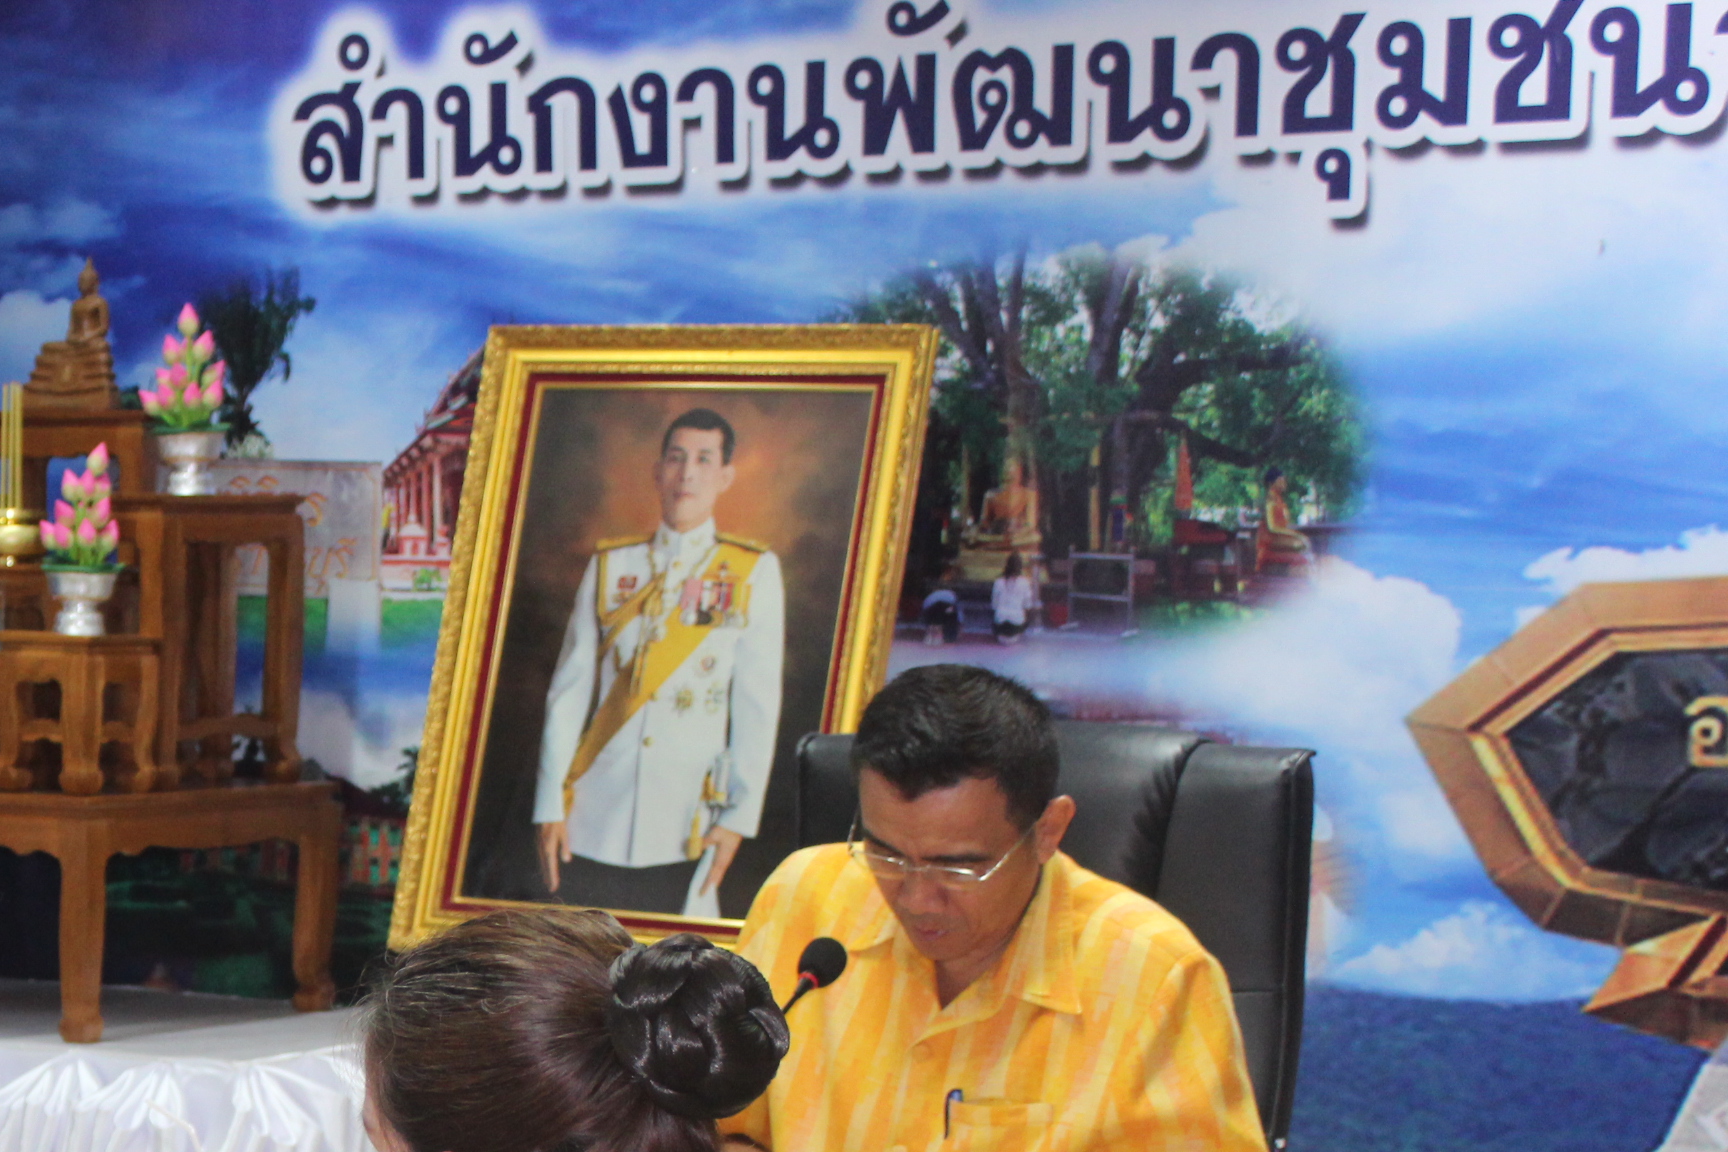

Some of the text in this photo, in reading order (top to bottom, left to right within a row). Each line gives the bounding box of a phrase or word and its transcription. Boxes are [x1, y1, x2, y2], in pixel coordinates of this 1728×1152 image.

[292, 0, 1728, 202] สำนักงานพัฒนาชุมชน
